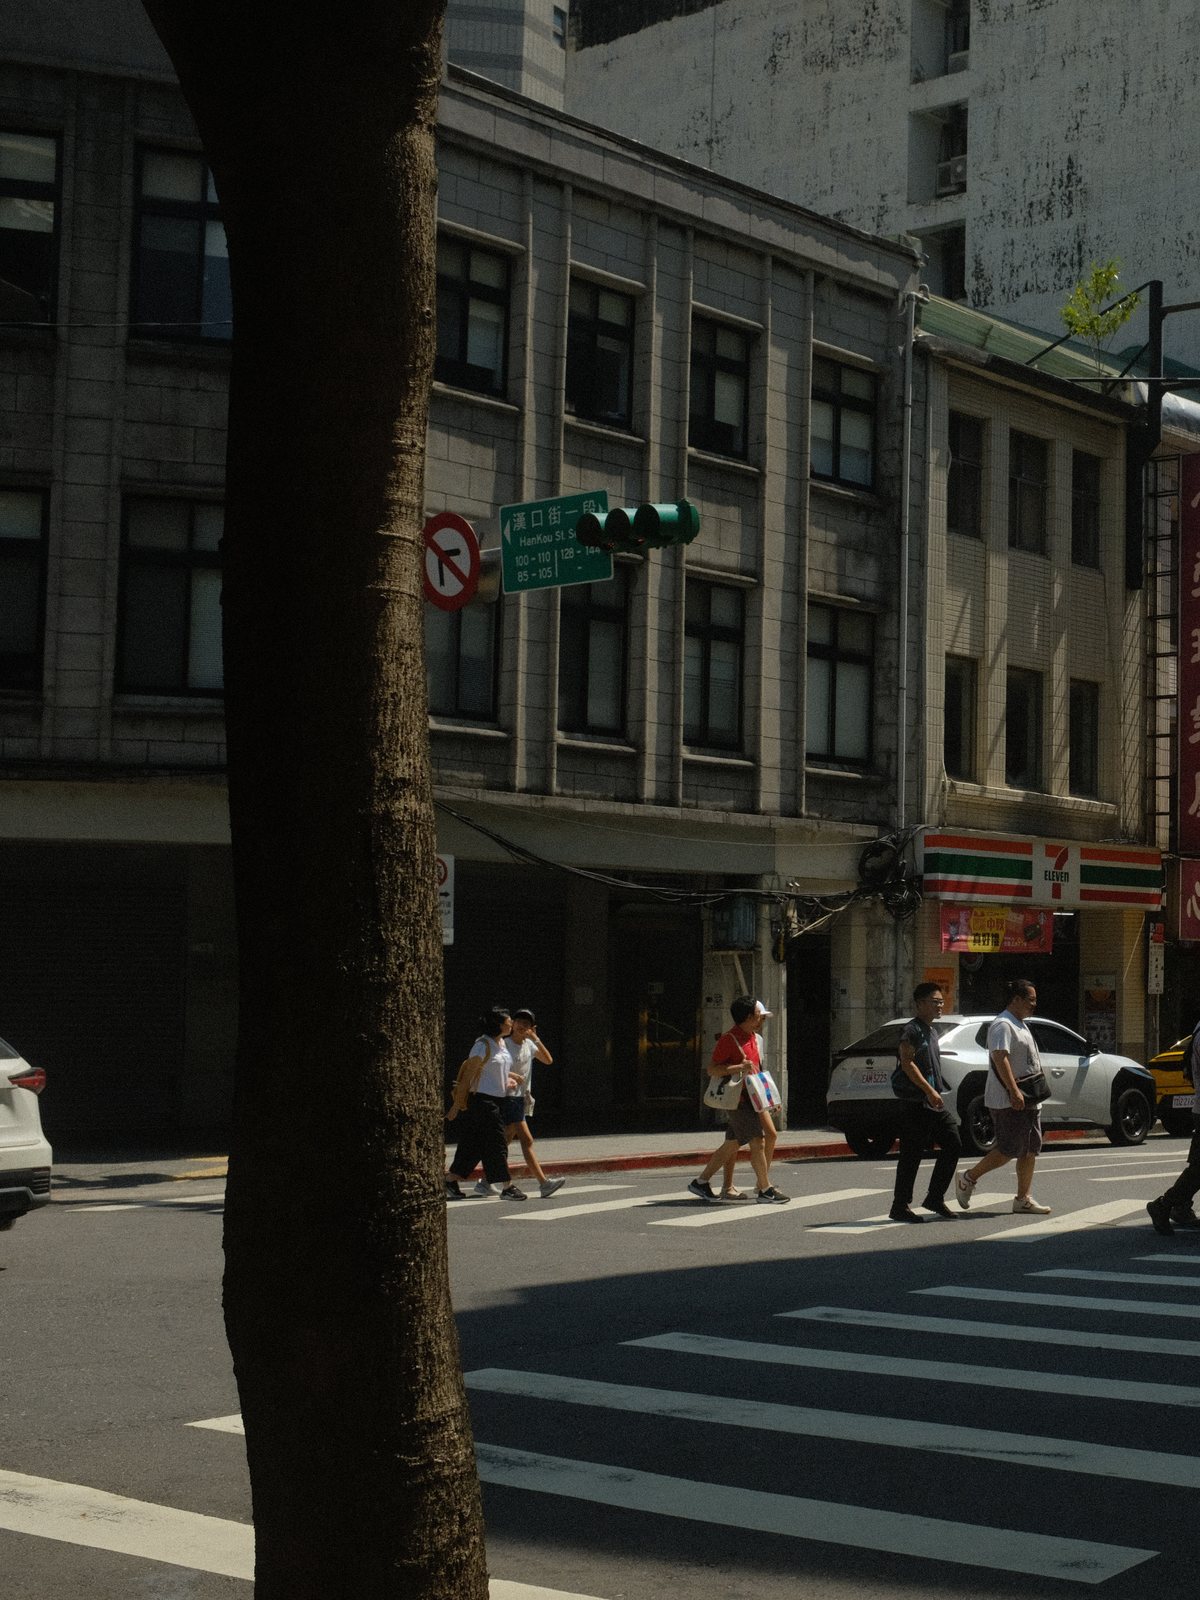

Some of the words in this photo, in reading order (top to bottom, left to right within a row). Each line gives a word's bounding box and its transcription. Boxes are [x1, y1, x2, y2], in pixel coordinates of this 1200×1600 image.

[513, 500, 597, 531] 漢口街一段
